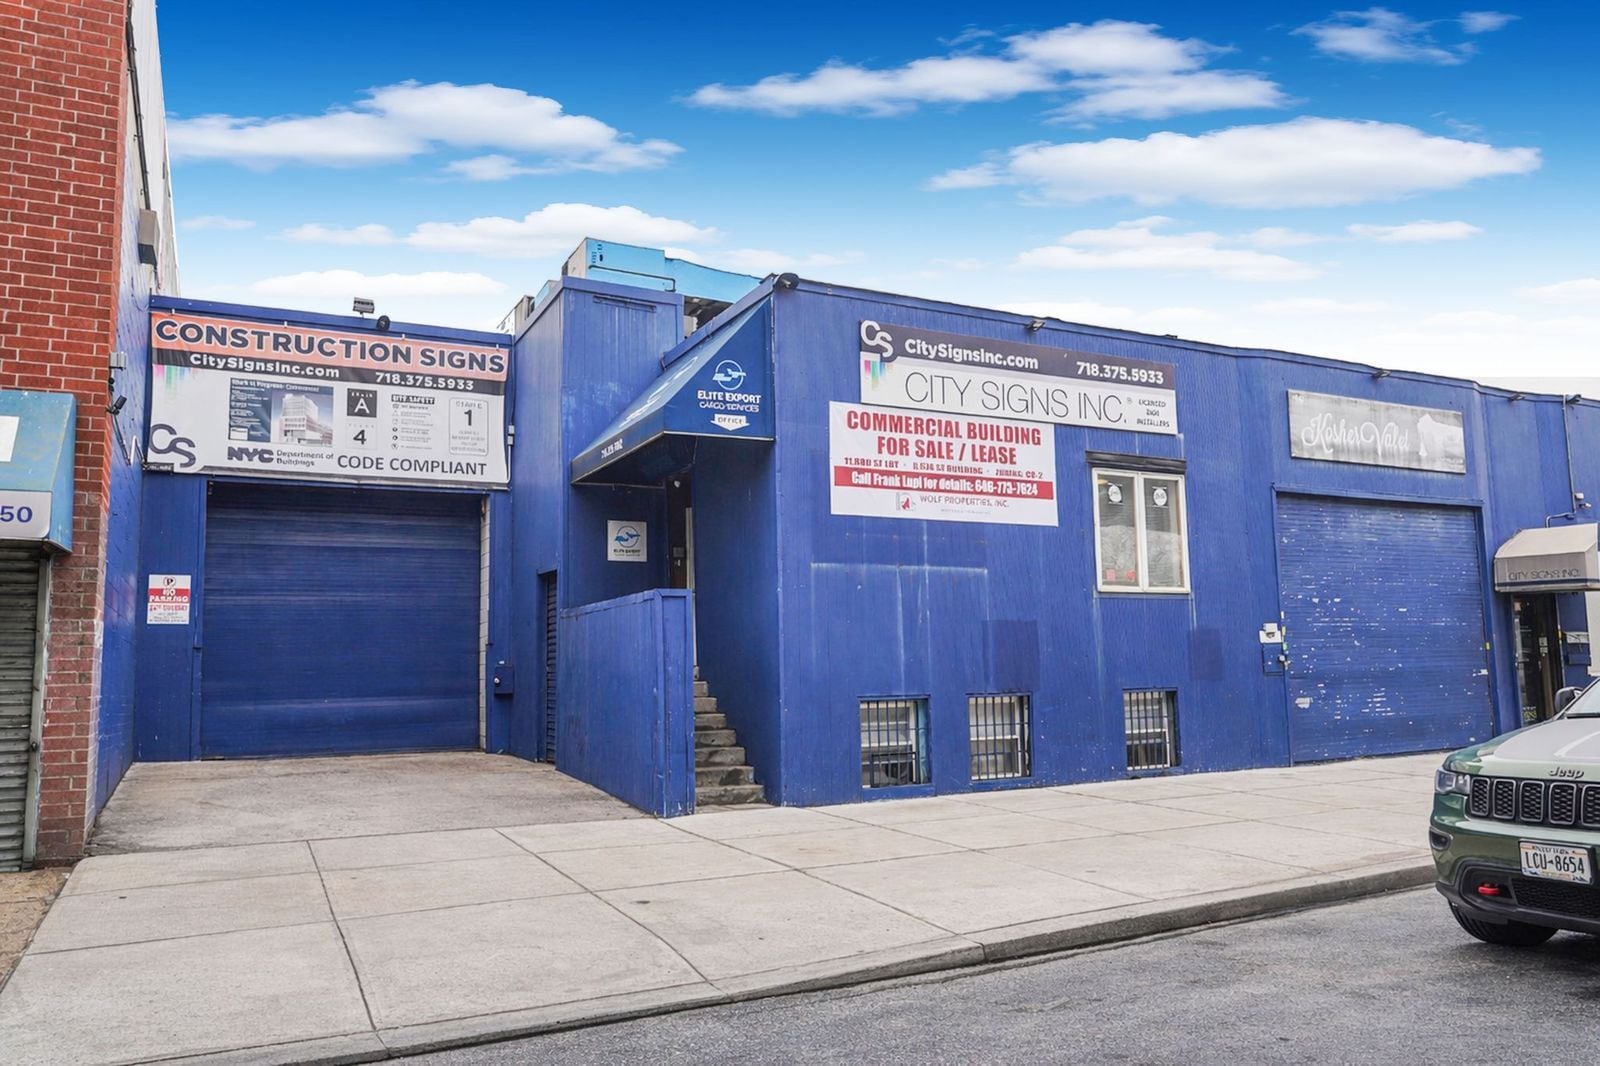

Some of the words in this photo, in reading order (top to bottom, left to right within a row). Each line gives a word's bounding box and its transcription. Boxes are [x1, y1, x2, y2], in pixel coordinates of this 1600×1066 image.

[155, 319, 412, 365] CONSTRUCTION
[420, 349, 505, 374] SIGNS
[860, 319, 893, 358] CS
[189, 353, 340, 379] CitySignsInc.com
[375, 371, 475, 391] 718.375.5933
[904, 338, 1039, 369] CitySignsInc.com
[1076, 361, 1164, 384] 718.375.5933
[353, 397, 370, 414] A
[697, 390, 724, 401] ELITE
[725, 392, 761, 404] EXPORT
[905, 371, 972, 407] CITY
[981, 380, 1069, 418] SIGNS
[1078, 391, 1127, 424] INC.
[464, 409, 473, 426] 1
[846, 410, 963, 439] COMMERCIAL
[966, 425, 1041, 446] BUILDING
[149, 423, 197, 468] CS
[353, 429, 367, 446] 4
[1302, 412, 1361, 454] Kosher
[227, 446, 274, 463] NYC
[276, 449, 324, 460] Department
[877, 435, 910, 457] FOR
[915, 439, 954, 461] SALE
[958, 443, 967, 462] /
[971, 443, 1017, 465] LEASE
[337, 454, 385, 471] CODE
[389, 457, 487, 476] COMPLIANT
[851, 470, 871, 485] Call
[873, 472, 901, 487] Frank
[0, 505, 33, 523] 50
